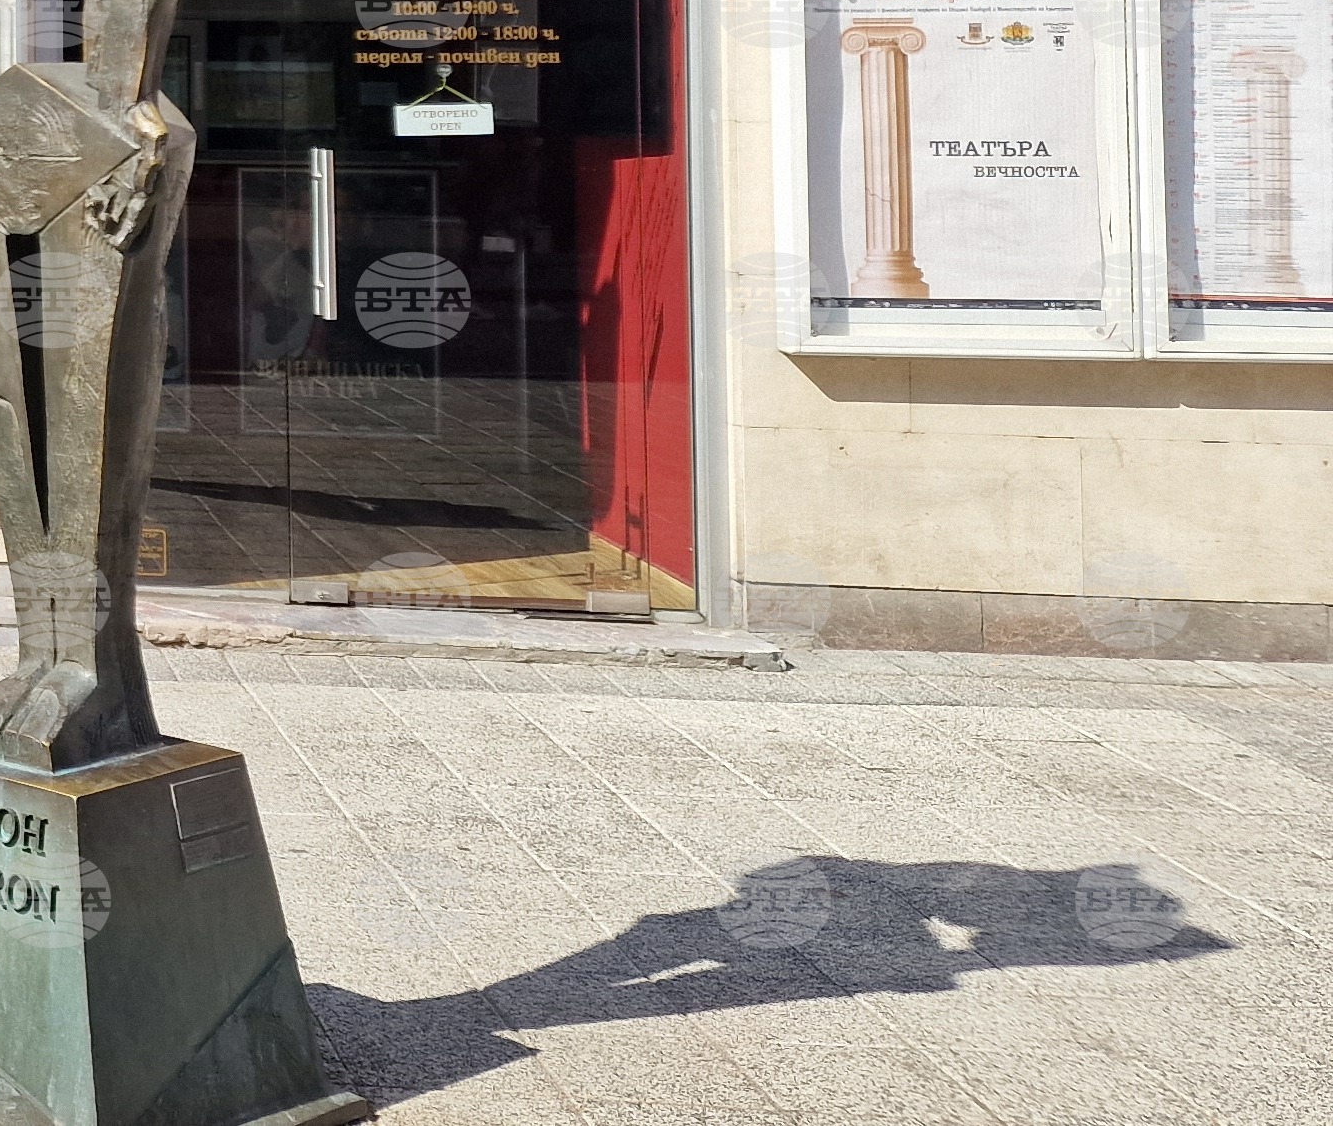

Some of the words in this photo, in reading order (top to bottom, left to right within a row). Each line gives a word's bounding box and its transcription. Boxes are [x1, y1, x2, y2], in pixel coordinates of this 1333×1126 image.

[393, 0, 438, 17] 10:00
[452, 0, 498, 16] 19:00
[355, 26, 428, 42] събота
[433, 25, 477, 42] 12:00
[493, 25, 538, 41] 18:00
[542, 28, 560, 41] ч.
[354, 51, 423, 68] неделя
[439, 49, 521, 65] почивен
[526, 50, 561, 68] ден
[413, 109, 479, 119] ОТВОРЕНО
[430, 122, 462, 131] OPEN
[929, 140, 1052, 158] ТЕАТЪРА
[973, 165, 1081, 179] ВЕЧНОСТТА
